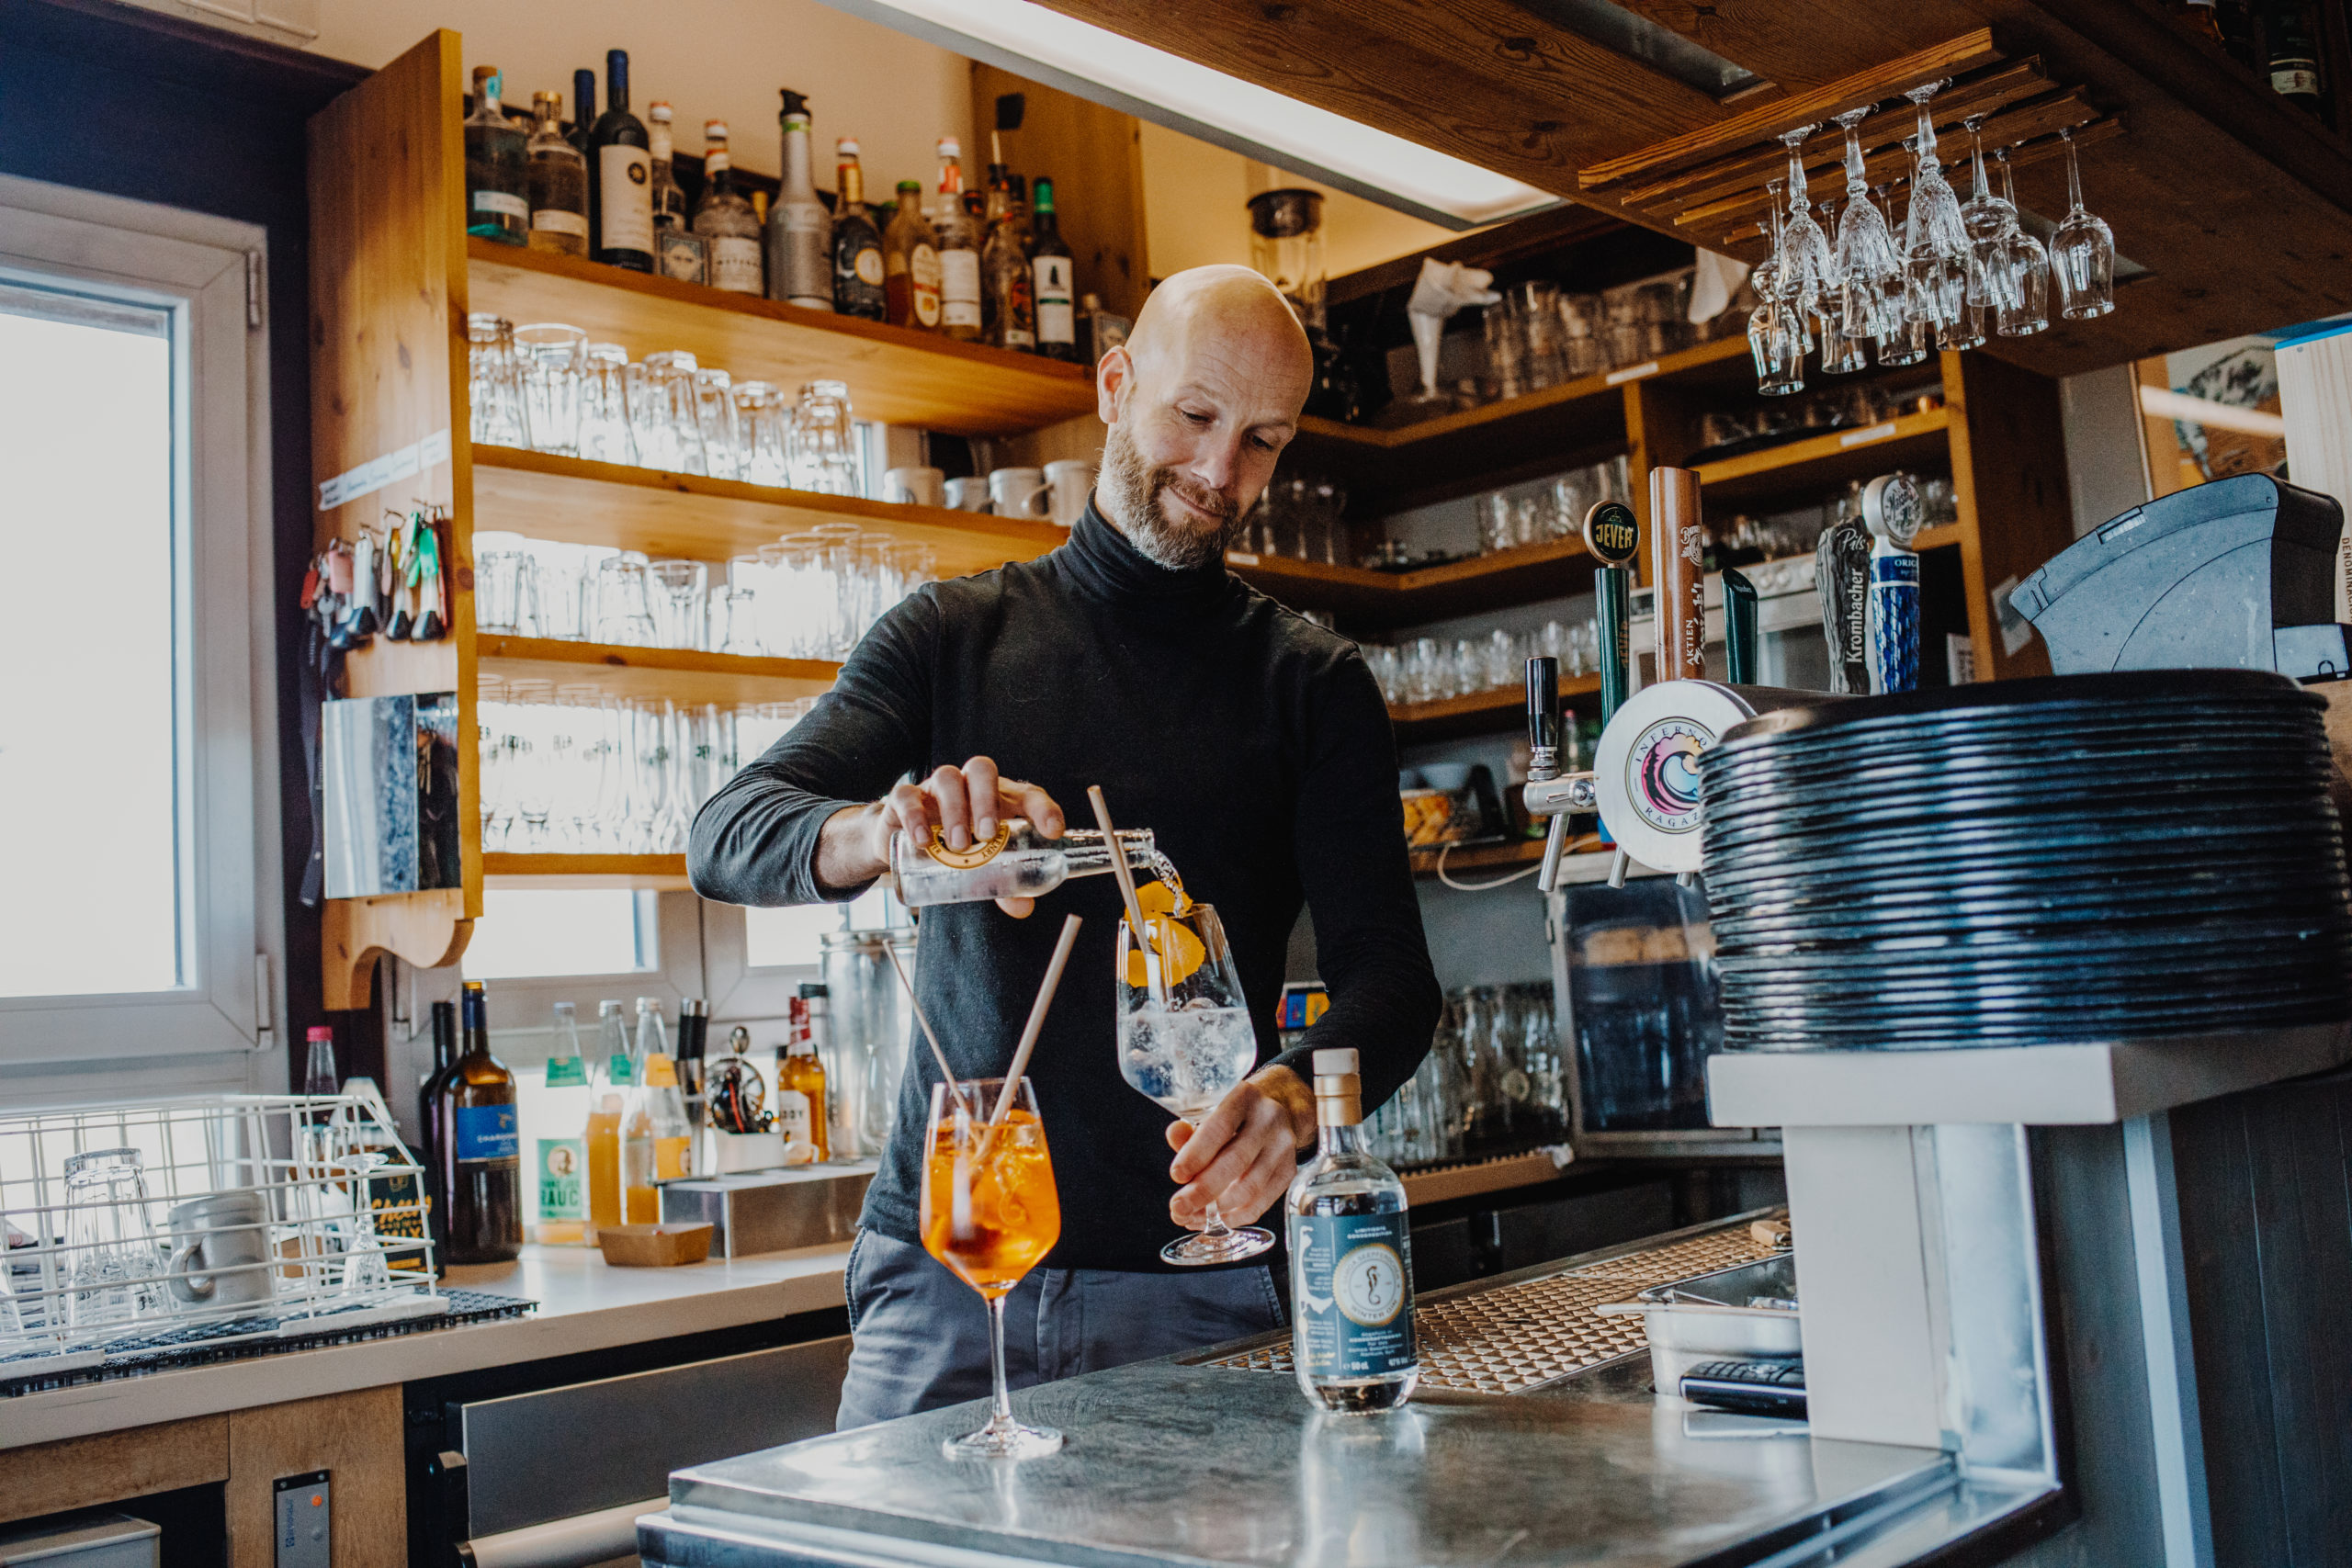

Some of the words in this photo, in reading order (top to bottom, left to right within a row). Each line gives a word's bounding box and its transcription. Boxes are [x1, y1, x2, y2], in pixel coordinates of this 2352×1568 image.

[1595, 524, 1634, 549] JEVER
[1837, 528, 1866, 551] Pils
[1847, 568, 1863, 663] Krombacher
[1686, 619, 1694, 666] AKTIEN
[1635, 726, 1707, 762] INFERNO
